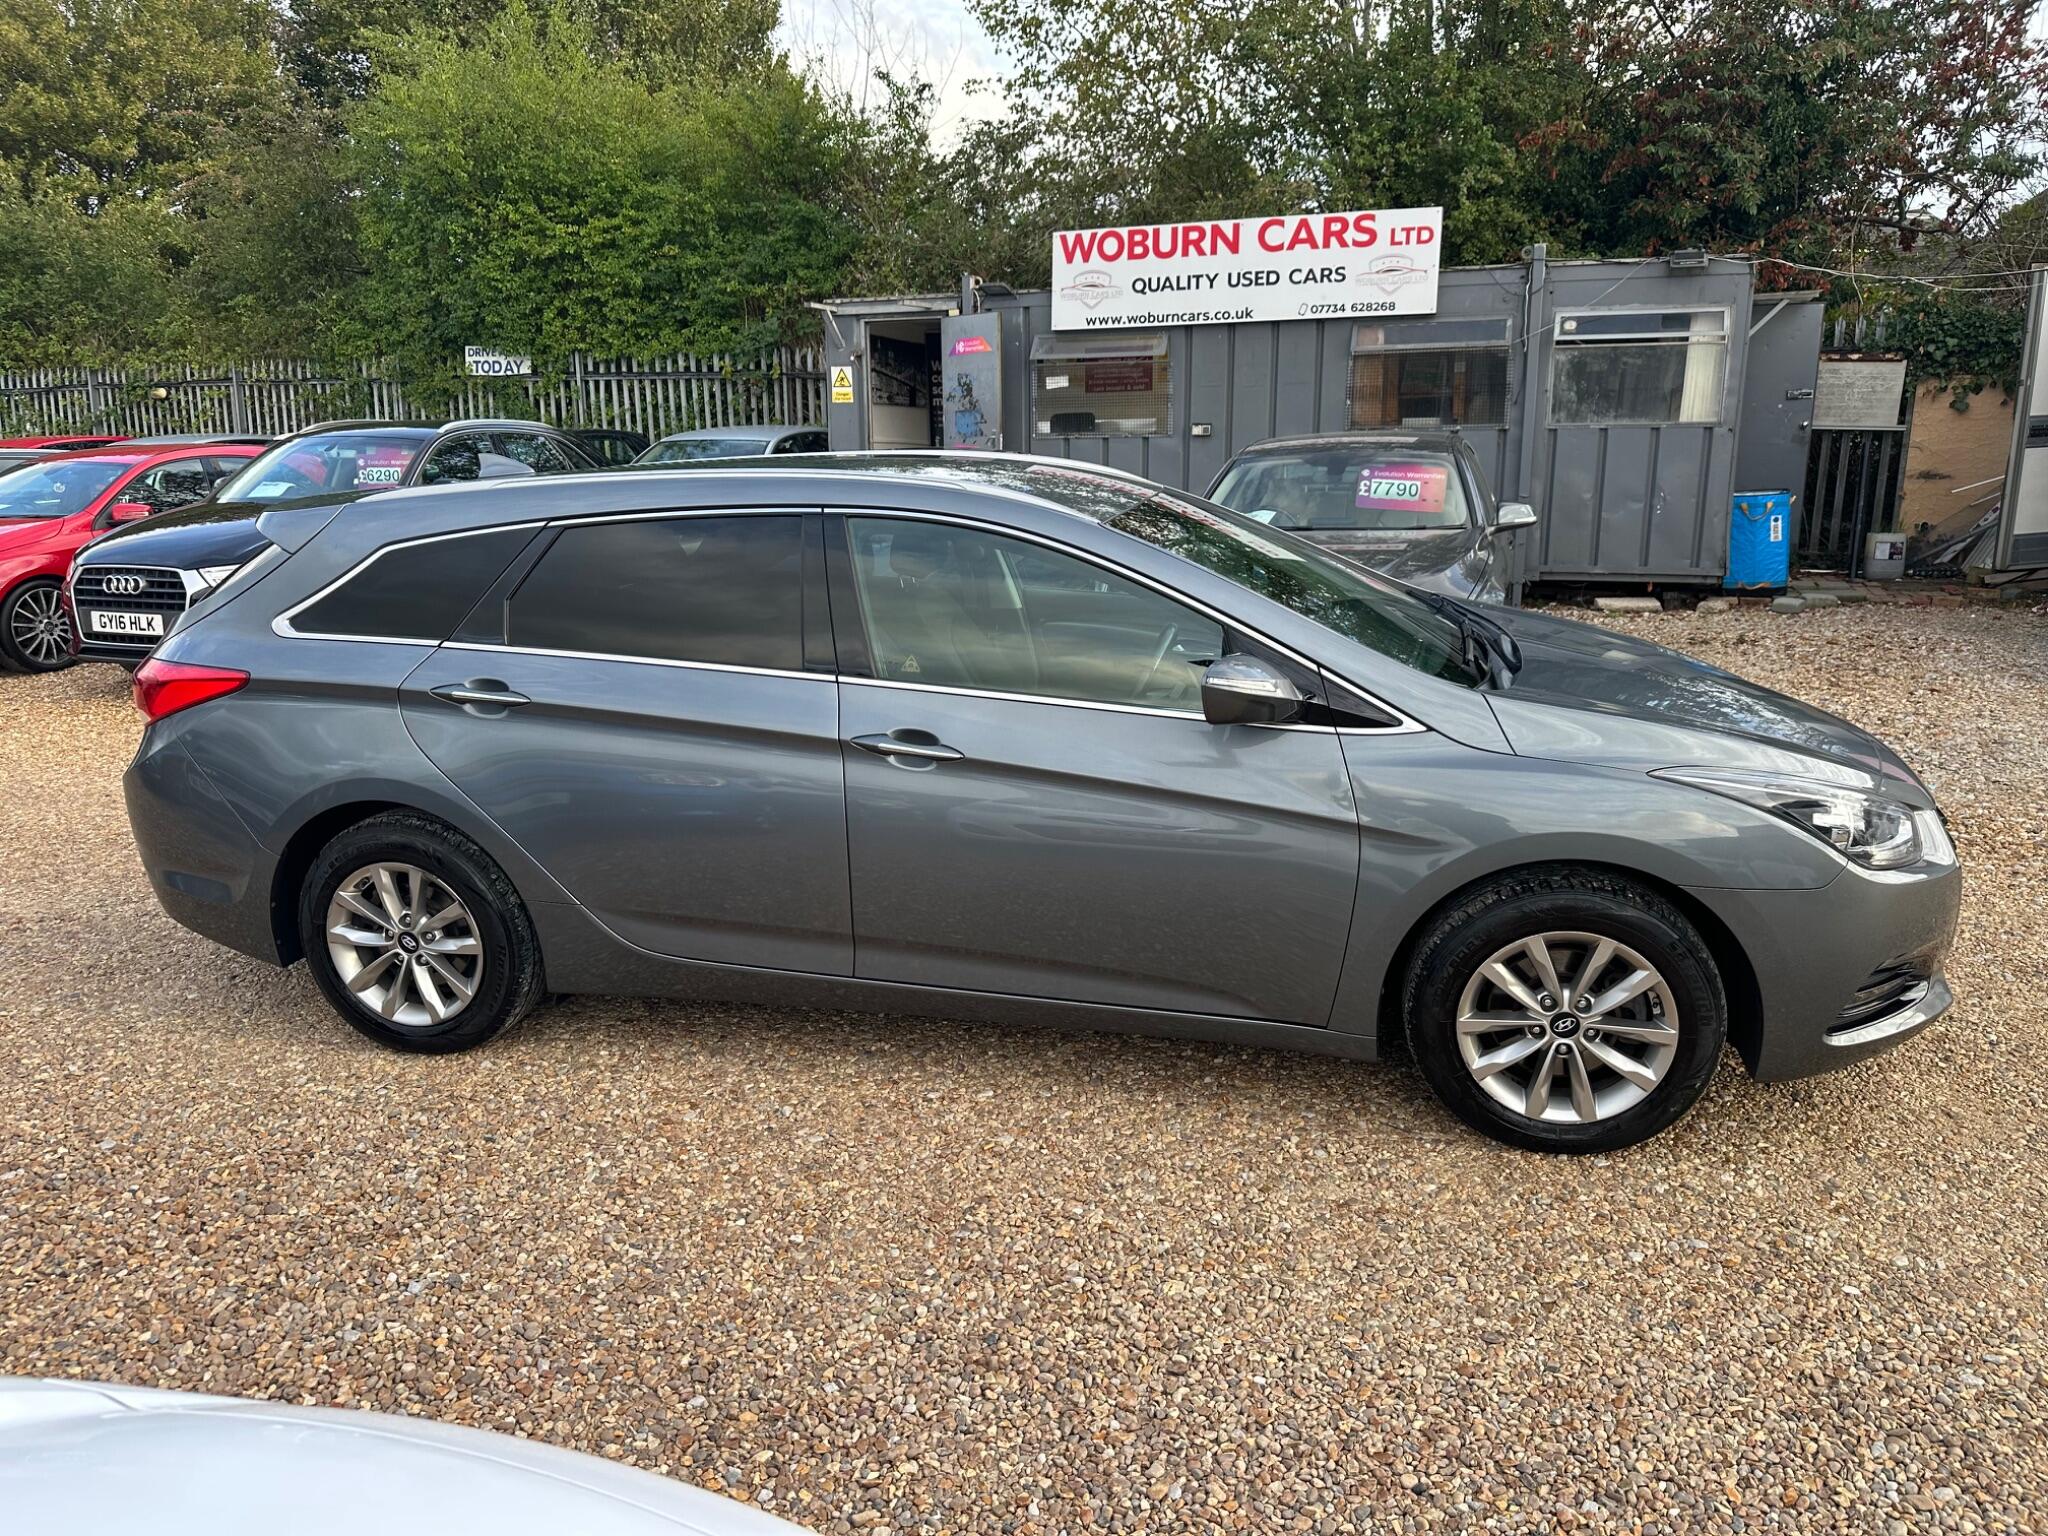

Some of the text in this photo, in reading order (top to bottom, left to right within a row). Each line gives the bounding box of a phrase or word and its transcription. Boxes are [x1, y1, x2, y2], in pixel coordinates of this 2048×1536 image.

[1060, 214, 1434, 264] WOBURN CARS LTD
[1132, 266, 1347, 295] QUALITY USED CARS
[1085, 307, 1254, 327] www.woburncars.co.uk
[1310, 302, 1396, 315] 07734 628268
[473, 360, 523, 374] TODAY
[1359, 480, 1419, 497] £7790
[99, 614, 155, 631] GY16 HLK
